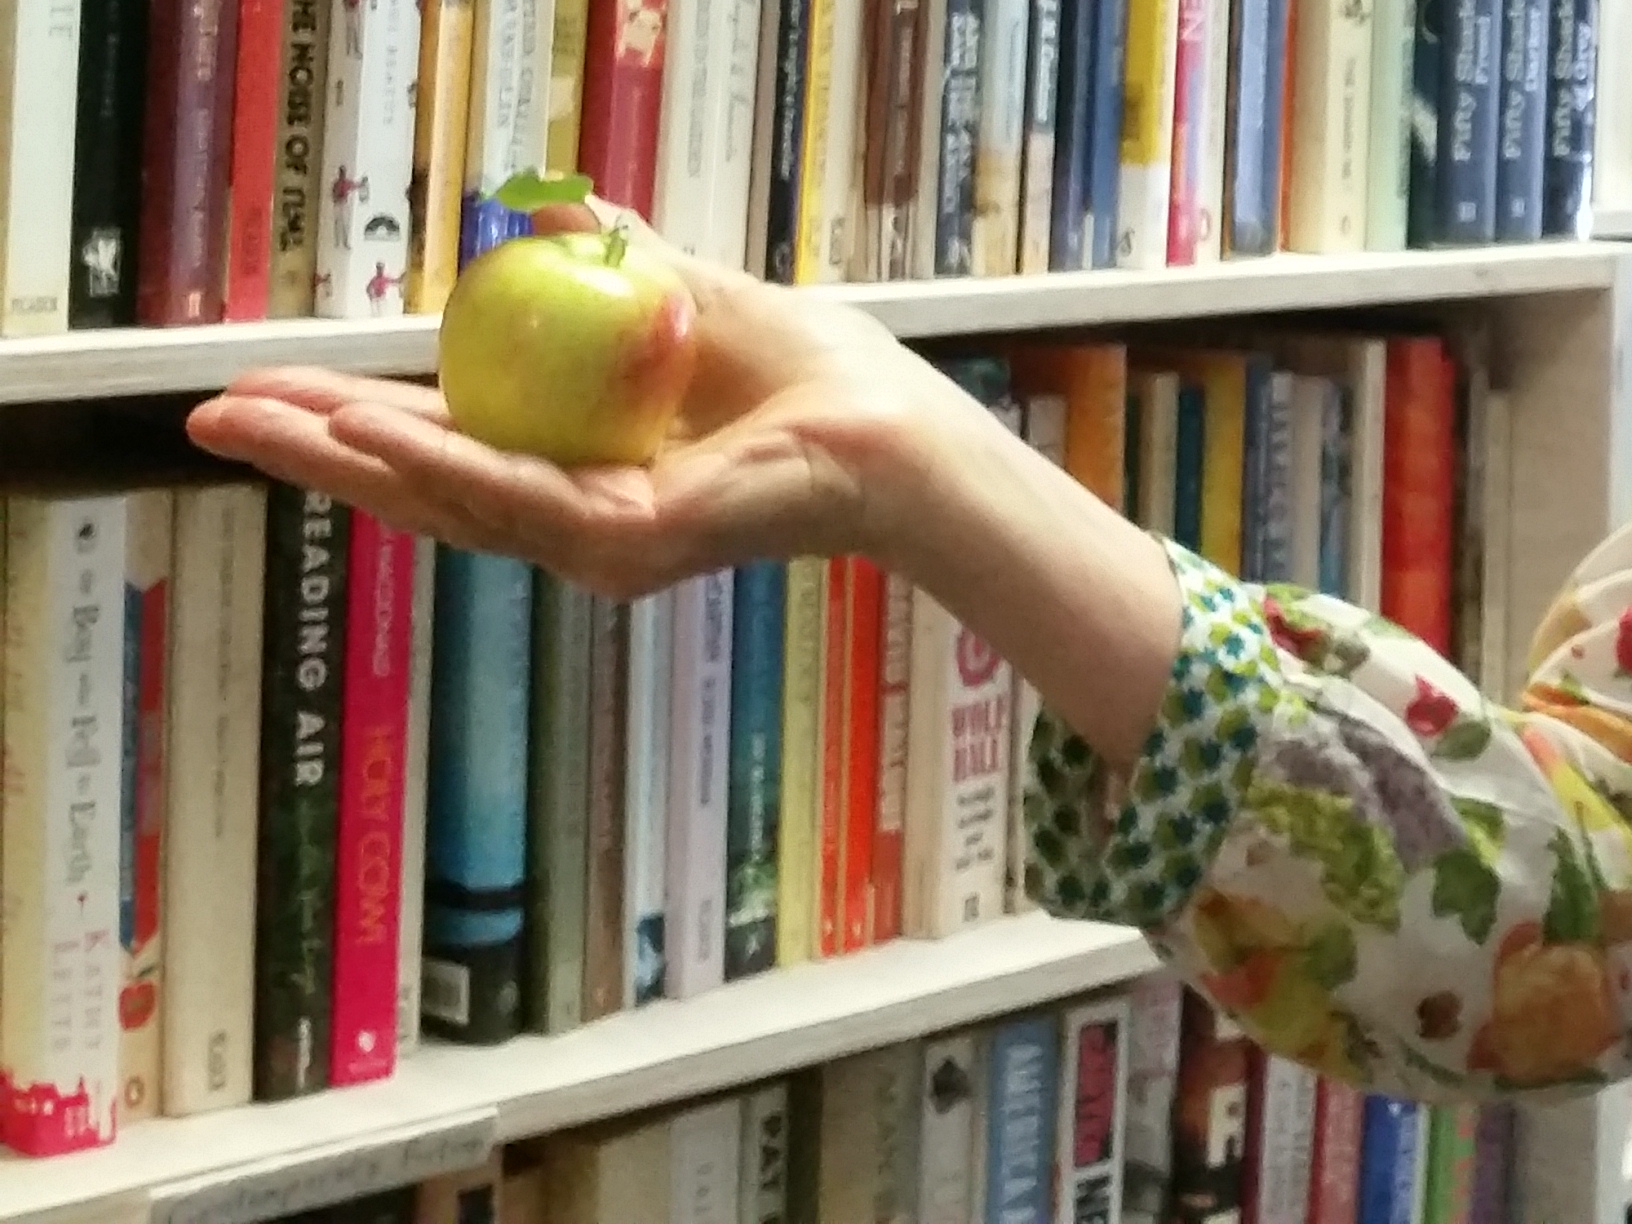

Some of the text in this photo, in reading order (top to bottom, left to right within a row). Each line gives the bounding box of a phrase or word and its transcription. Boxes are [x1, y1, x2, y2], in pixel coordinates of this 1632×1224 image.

[286, 42, 315, 127] NOISE
[1551, 87, 1573, 158] Fifty
[285, 133, 311, 177] OF
[1451, 90, 1478, 162] Fifty
[1502, 89, 1527, 161] Fifty
[62, 604, 101, 664] Boy
[295, 491, 333, 788] READING AIR
[358, 725, 394, 821] HOLY
[52, 940, 81, 1051] LETTE
[84, 929, 111, 1050] KATHY
